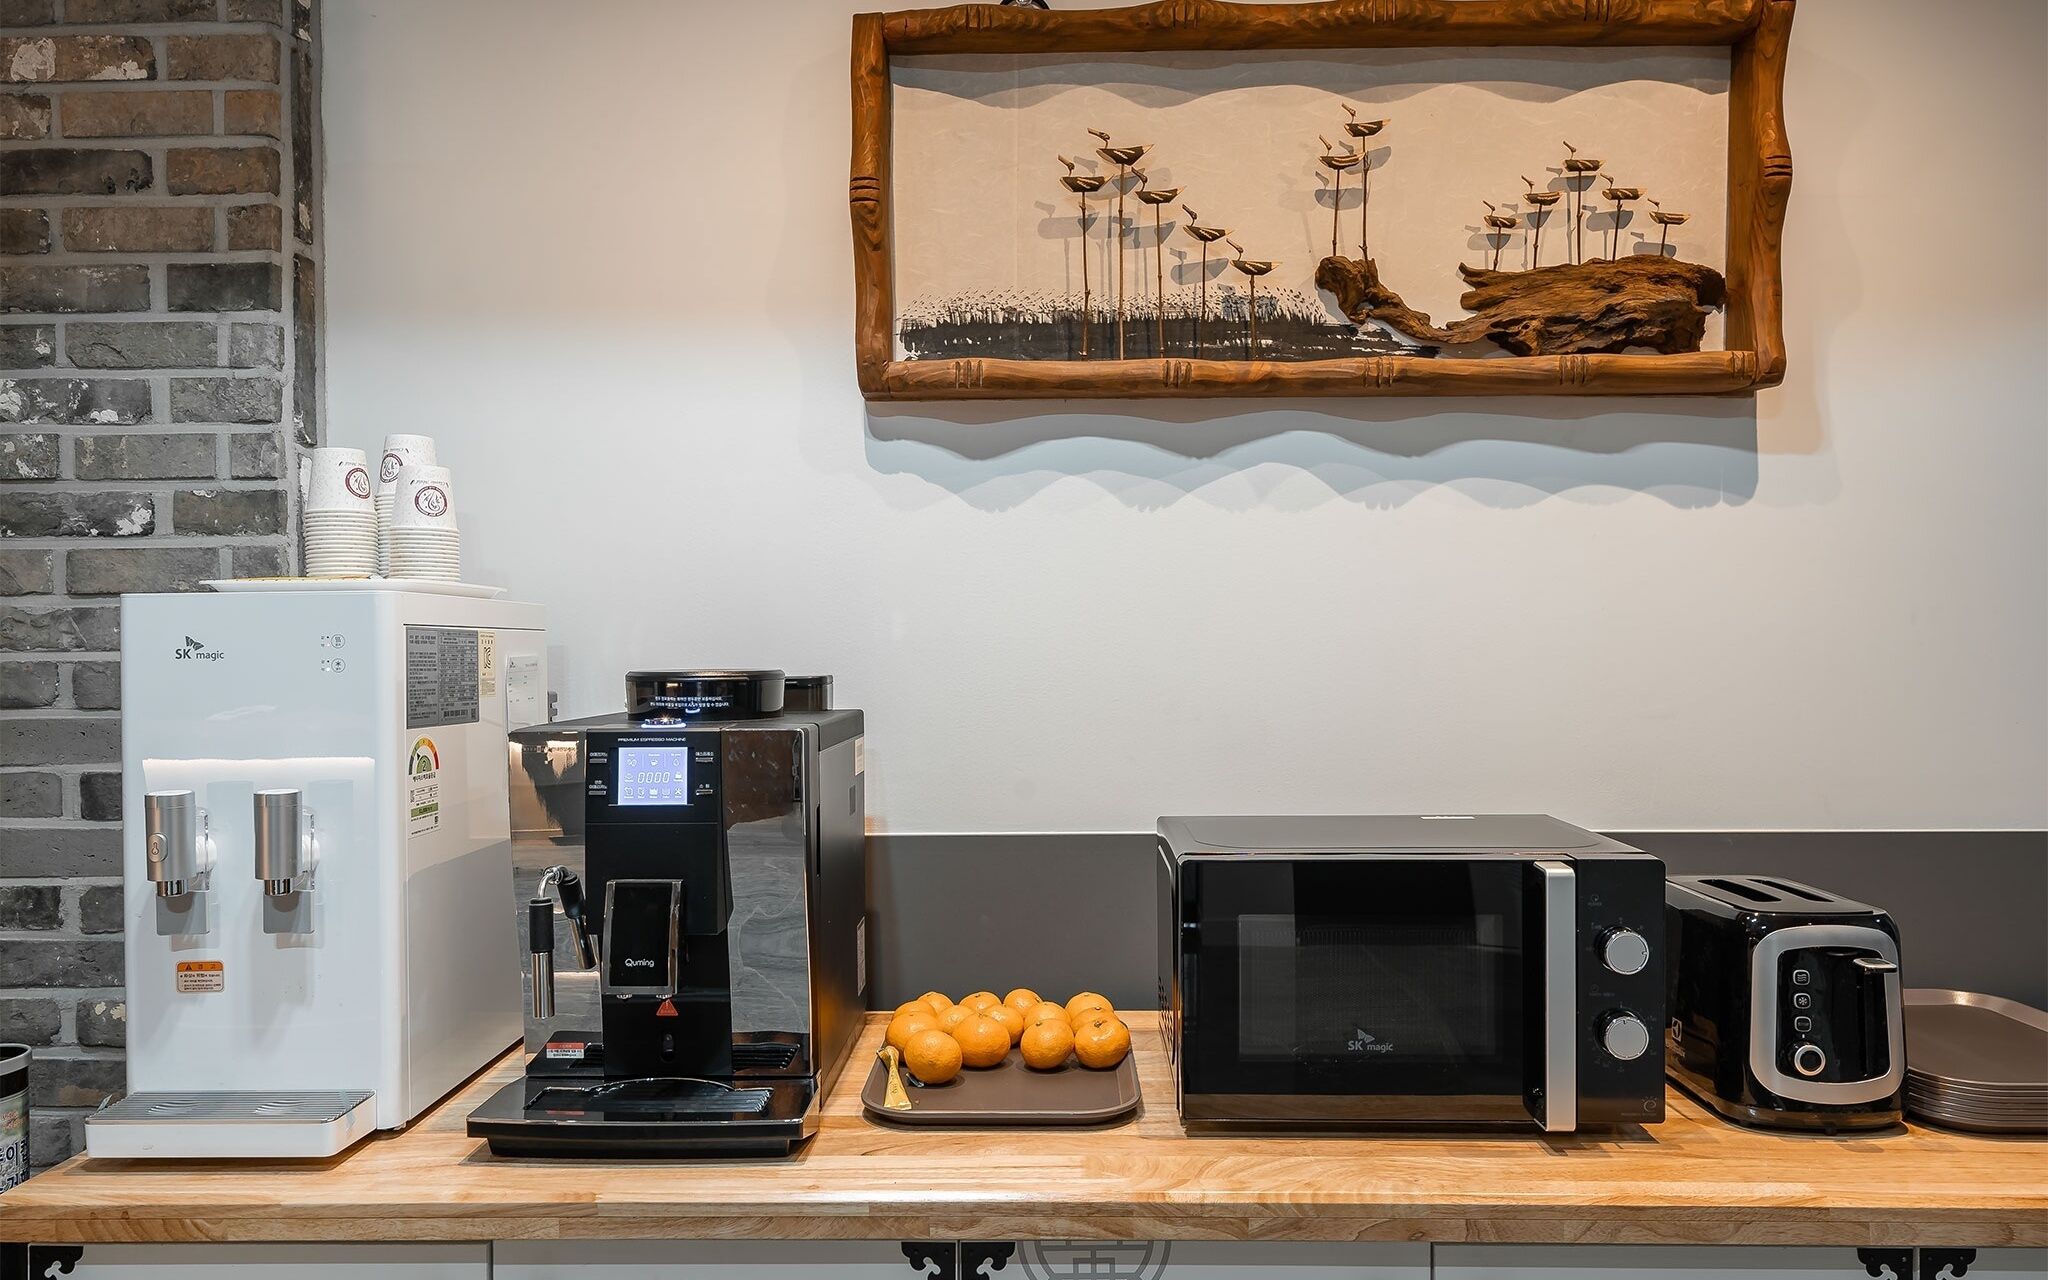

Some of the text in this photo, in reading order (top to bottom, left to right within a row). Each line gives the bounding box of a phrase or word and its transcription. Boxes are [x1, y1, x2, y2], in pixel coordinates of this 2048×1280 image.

[175, 648, 225, 662] SK magic
[624, 958, 655, 968] Quming
[1348, 1040, 1394, 1053] SK magic
